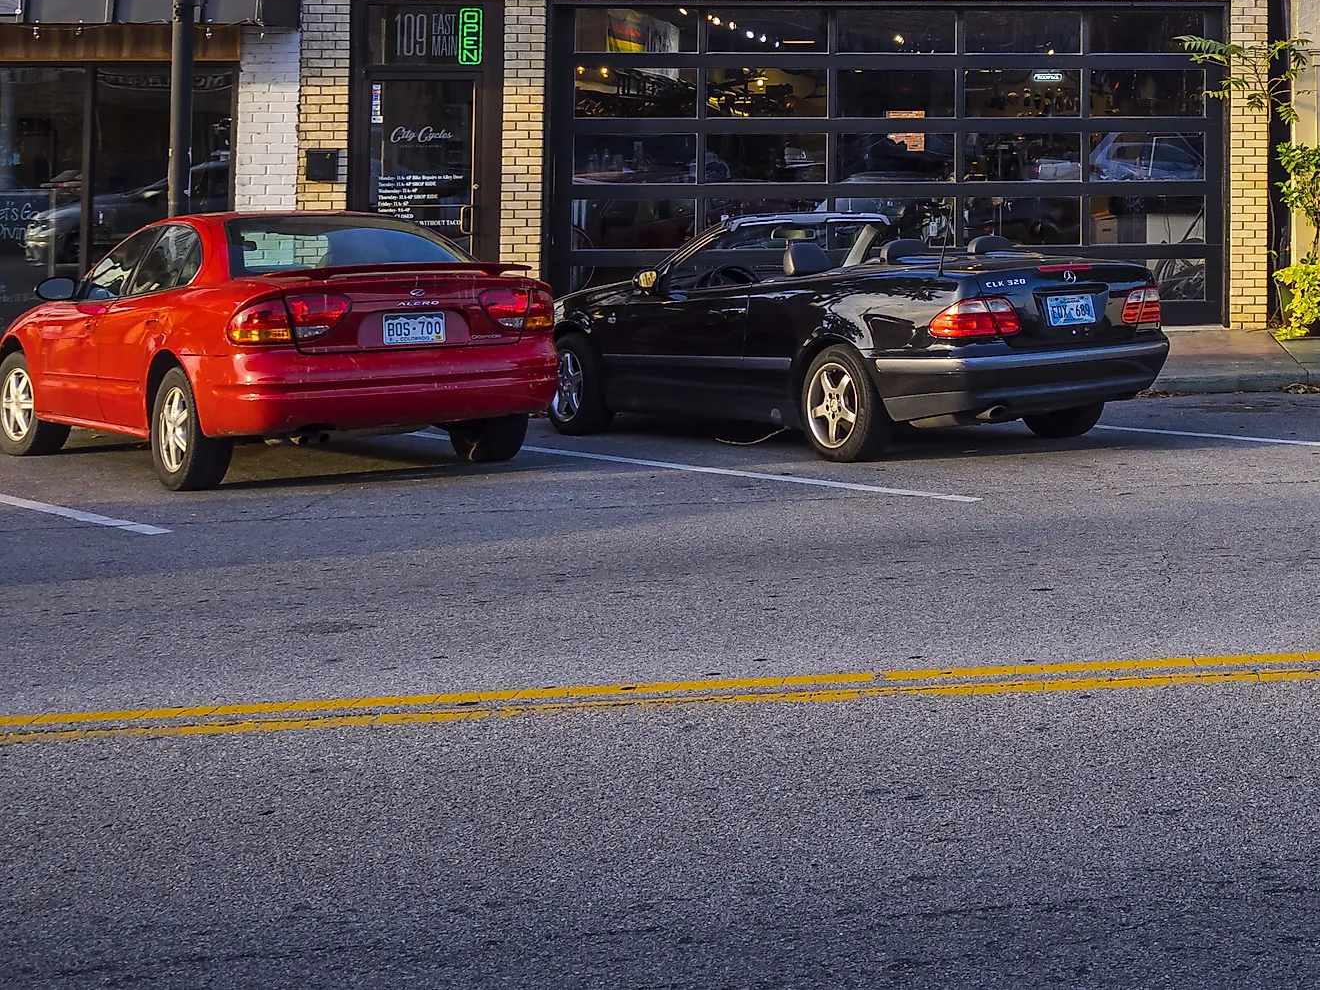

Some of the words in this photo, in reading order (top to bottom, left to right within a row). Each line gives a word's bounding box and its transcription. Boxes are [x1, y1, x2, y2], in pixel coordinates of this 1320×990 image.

[395, 14, 427, 56] 109
[432, 14, 457, 35] EAST
[431, 35, 458, 57] MAIN
[462, 11, 479, 62] OPEN
[390, 126, 417, 143] City
[417, 126, 454, 143] Cycles
[985, 281, 1005, 289] CLK
[1006, 278, 1027, 287] 320
[397, 299, 441, 307] ALERO
